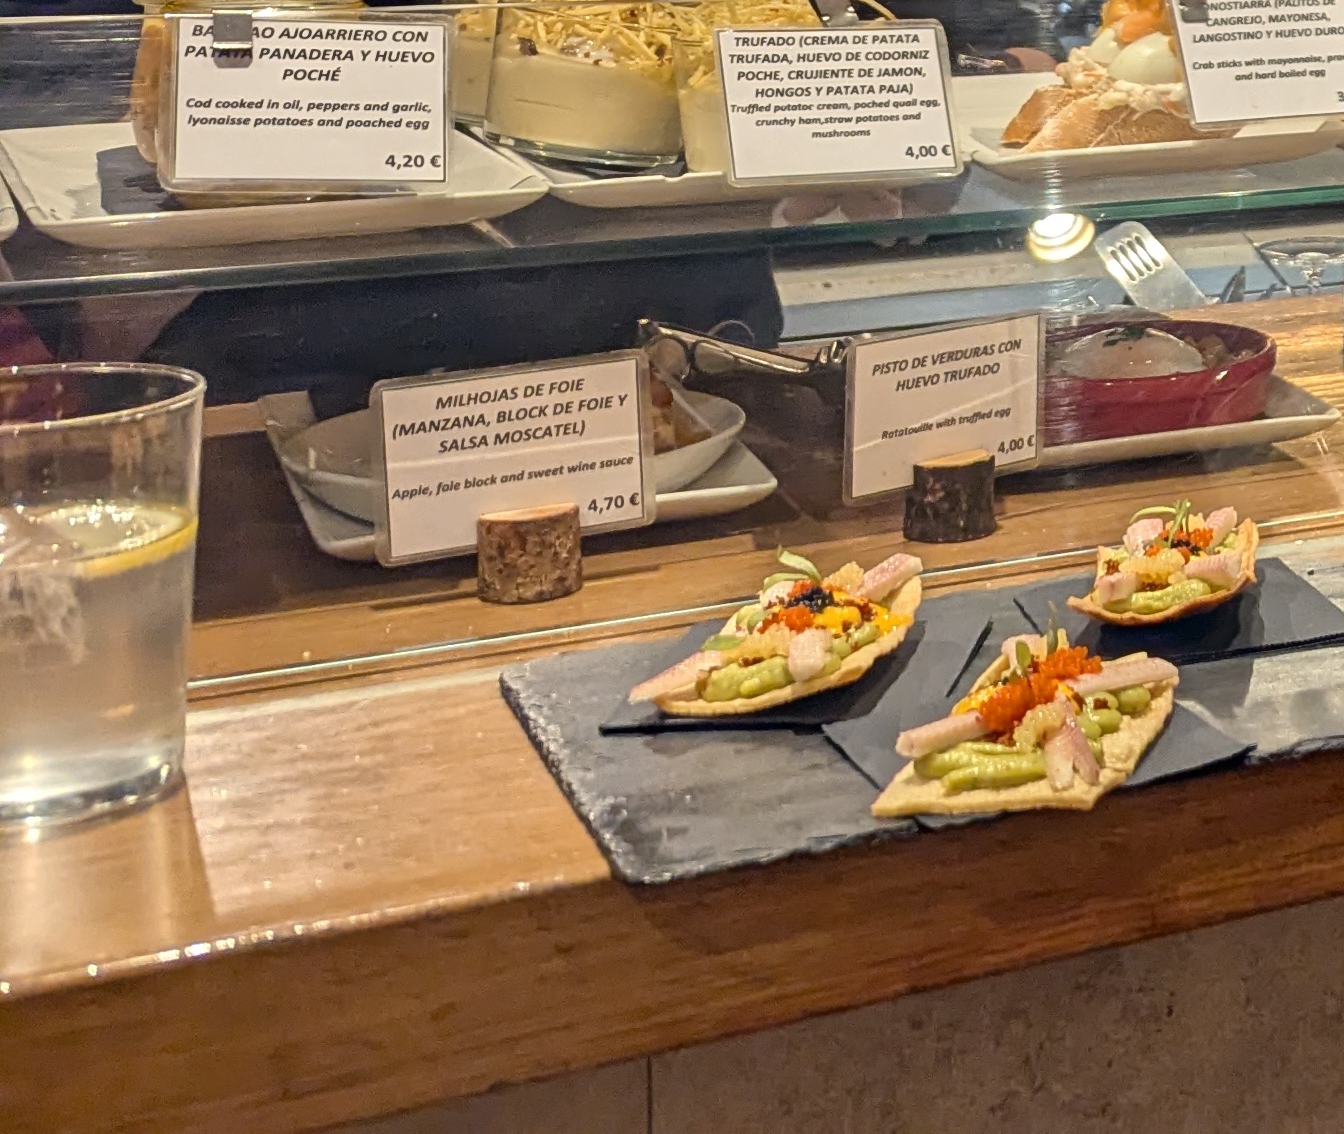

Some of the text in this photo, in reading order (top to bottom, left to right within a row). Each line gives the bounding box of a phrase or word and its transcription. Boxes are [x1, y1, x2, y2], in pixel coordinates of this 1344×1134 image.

[1204, 0, 1272, 11] ONOSTIARRA
[1206, 13, 1331, 27] CANGREJO, MAYONESA,
[191, 24, 428, 42] BAAO AJOARRIERO CON
[735, 34, 920, 47] TRUFADO (CREMA DE PATATA
[1193, 30, 1263, 43] LANGOSTINO
[1266, 30, 1273, 38] Y
[1275, 28, 1312, 38] HUEVO
[258, 47, 354, 61] PANADERA
[360, 50, 370, 61] Y
[374, 51, 435, 63] HUEVO
[729, 50, 929, 65] TRUFADA, HUEVO DE CODORNIZ
[1193, 61, 1214, 70] Crab
[1217, 59, 1242, 68] sticks
[1245, 58, 1265, 66] with
[1268, 55, 1325, 66] mayonnaise,
[282, 67, 341, 82] POCHÉ
[737, 67, 926, 82] POCHE, CRUJIENTE DE JAMON,
[1235, 69, 1326, 81] and hard boiled egg
[755, 84, 913, 98] HONGOS Y PATATA PAJA)
[186, 98, 432, 114] Cod cooked in oil, peppers and garlic,
[731, 104, 771, 114] Truffled
[817, 102, 851, 111] cream,
[854, 100, 890, 110] poched
[893, 99, 917, 109] quail
[188, 115, 430, 130] lyonaisse potatoes and poached egg
[756, 118, 796, 126] crunchy
[856, 113, 900, 124] potatoes
[812, 129, 871, 138] mushrooms
[906, 144, 951, 159] 4,00 €
[385, 155, 441, 170] 4,20 €
[872, 339, 1022, 376] PISTO DE VERDURAS CON
[896, 362, 1000, 392] HUEVO TRUFADO
[436, 378, 585, 410] MILHOJAS DE FOIE
[392, 394, 628, 440] (MANZANA, BLOCK DE FOIE Y
[881, 407, 1011, 440] Ratatouille with truffled egg
[438, 420, 586, 454] SALSA MOSCATEL)
[997, 435, 1034, 454] 4,00 €
[392, 454, 634, 500] Apple, foie block and sweet wine sauce
[588, 492, 640, 514] 4,70 €
